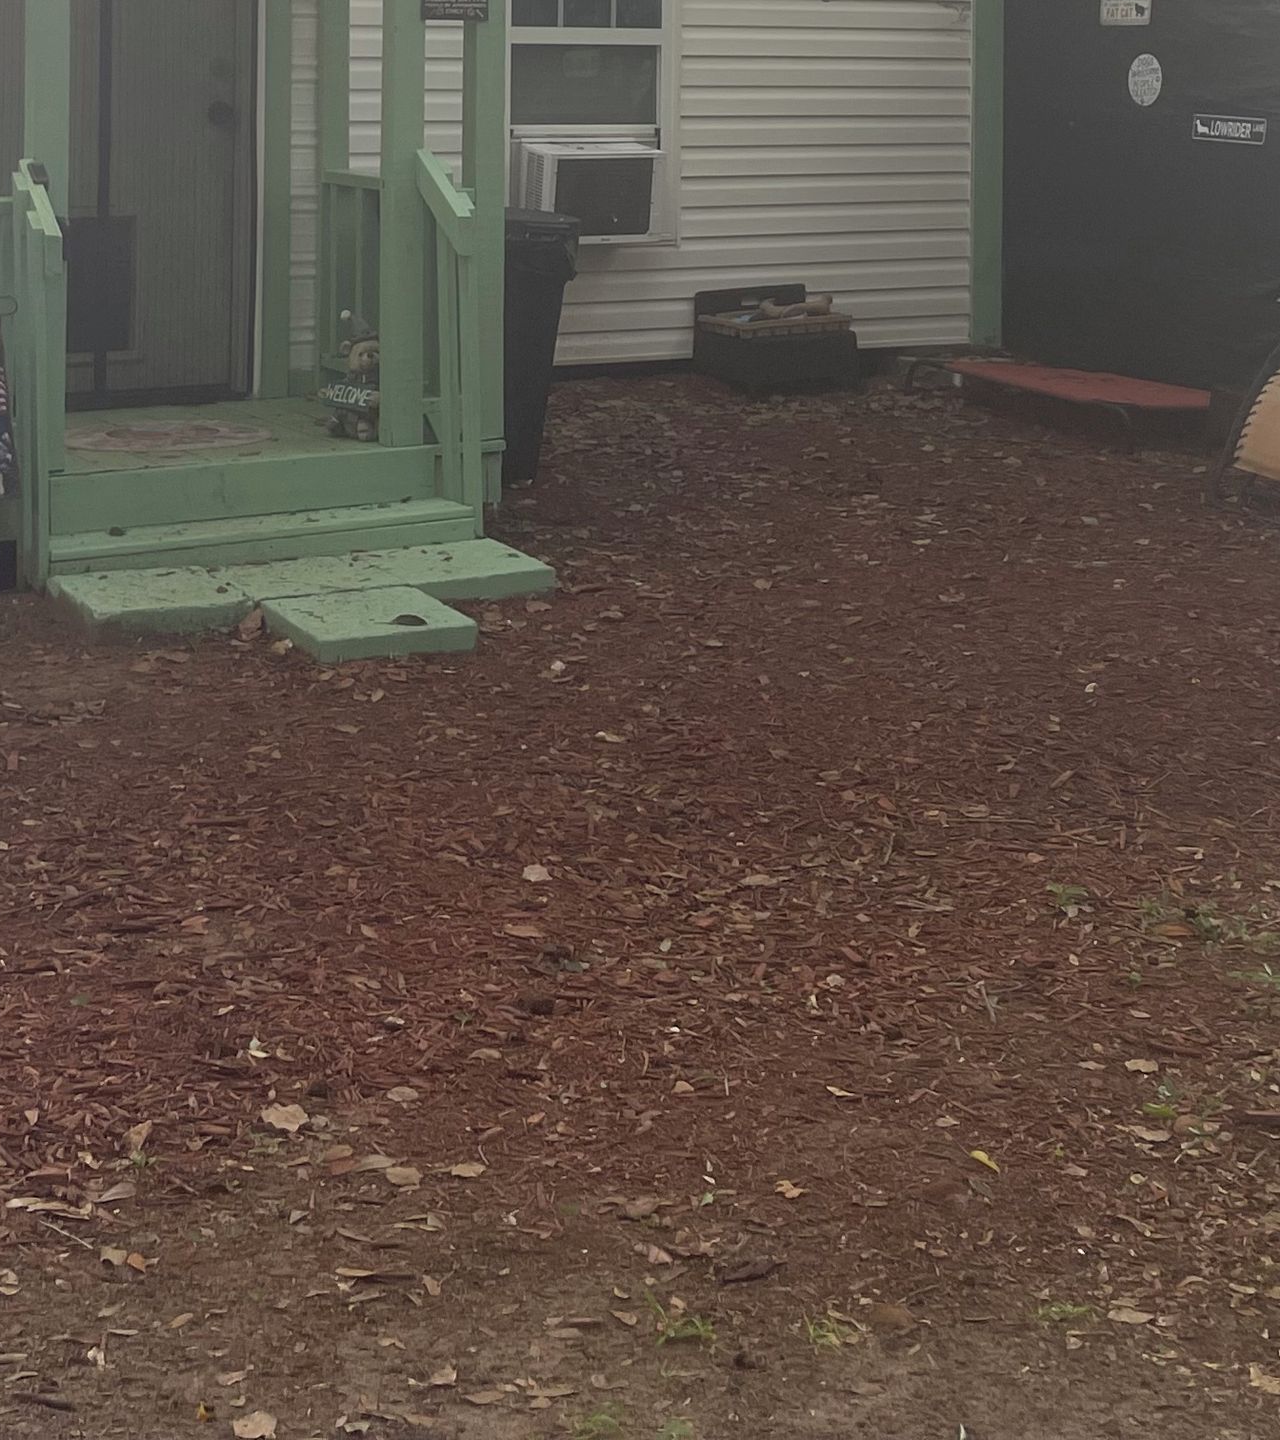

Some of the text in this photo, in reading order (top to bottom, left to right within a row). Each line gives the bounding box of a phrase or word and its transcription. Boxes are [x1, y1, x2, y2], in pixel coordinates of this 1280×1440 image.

[1121, 7, 1134, 18] CAT
[1210, 120, 1251, 139] LOWRIDER
[326, 383, 372, 407] WELCOME
